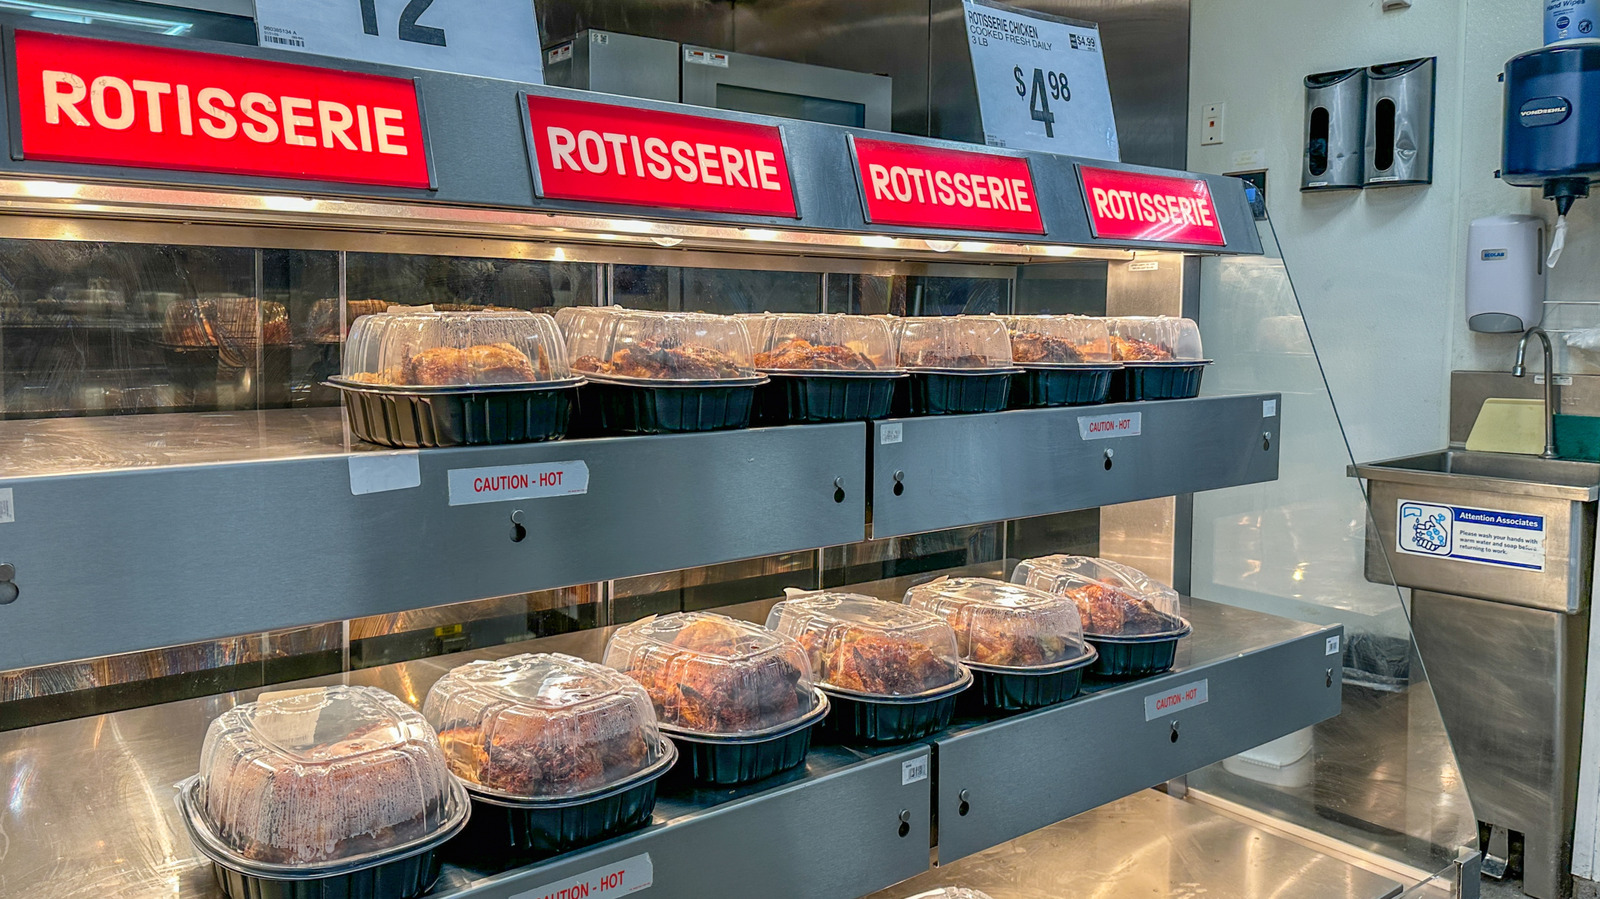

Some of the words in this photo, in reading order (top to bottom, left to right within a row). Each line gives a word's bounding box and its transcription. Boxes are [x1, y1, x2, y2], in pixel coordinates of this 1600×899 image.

[968, 10, 1009, 33] ROTISSERIE
[1008, 19, 1039, 39] CHICKEN
[970, 25, 1004, 41] COOKED
[1005, 33, 1032, 46] FRESH
[1032, 39, 1053, 51] DAILY
[972, 36, 977, 44] 3
[979, 37, 989, 47] LB
[1077, 35, 1096, 48] $4.99
[42, 69, 408, 156] ROTISSERIE
[547, 126, 781, 191] ROTISSERIE
[868, 163, 1032, 212] ROTISSERIE
[1092, 187, 1214, 227] ROTISSERIE
[1089, 420, 1115, 433] CAUTION
[1118, 419, 1131, 430] HOT
[473, 474, 528, 493] CAUTION
[539, 471, 563, 487] HOT
[1459, 511, 1495, 524] Attention
[1496, 516, 1539, 528] Associates
[1459, 529, 1477, 537] Please
[1478, 531, 1493, 539] wash
[1493, 534, 1506, 542] your
[1506, 535, 1524, 543] hands
[1525, 536, 1538, 545] with
[1459, 544, 1484, 553] returning
[1155, 693, 1182, 710] CAUTION
[1185, 688, 1198, 700] HOT
[536, 882, 589, 899] TION
[600, 870, 625, 892] HOT
